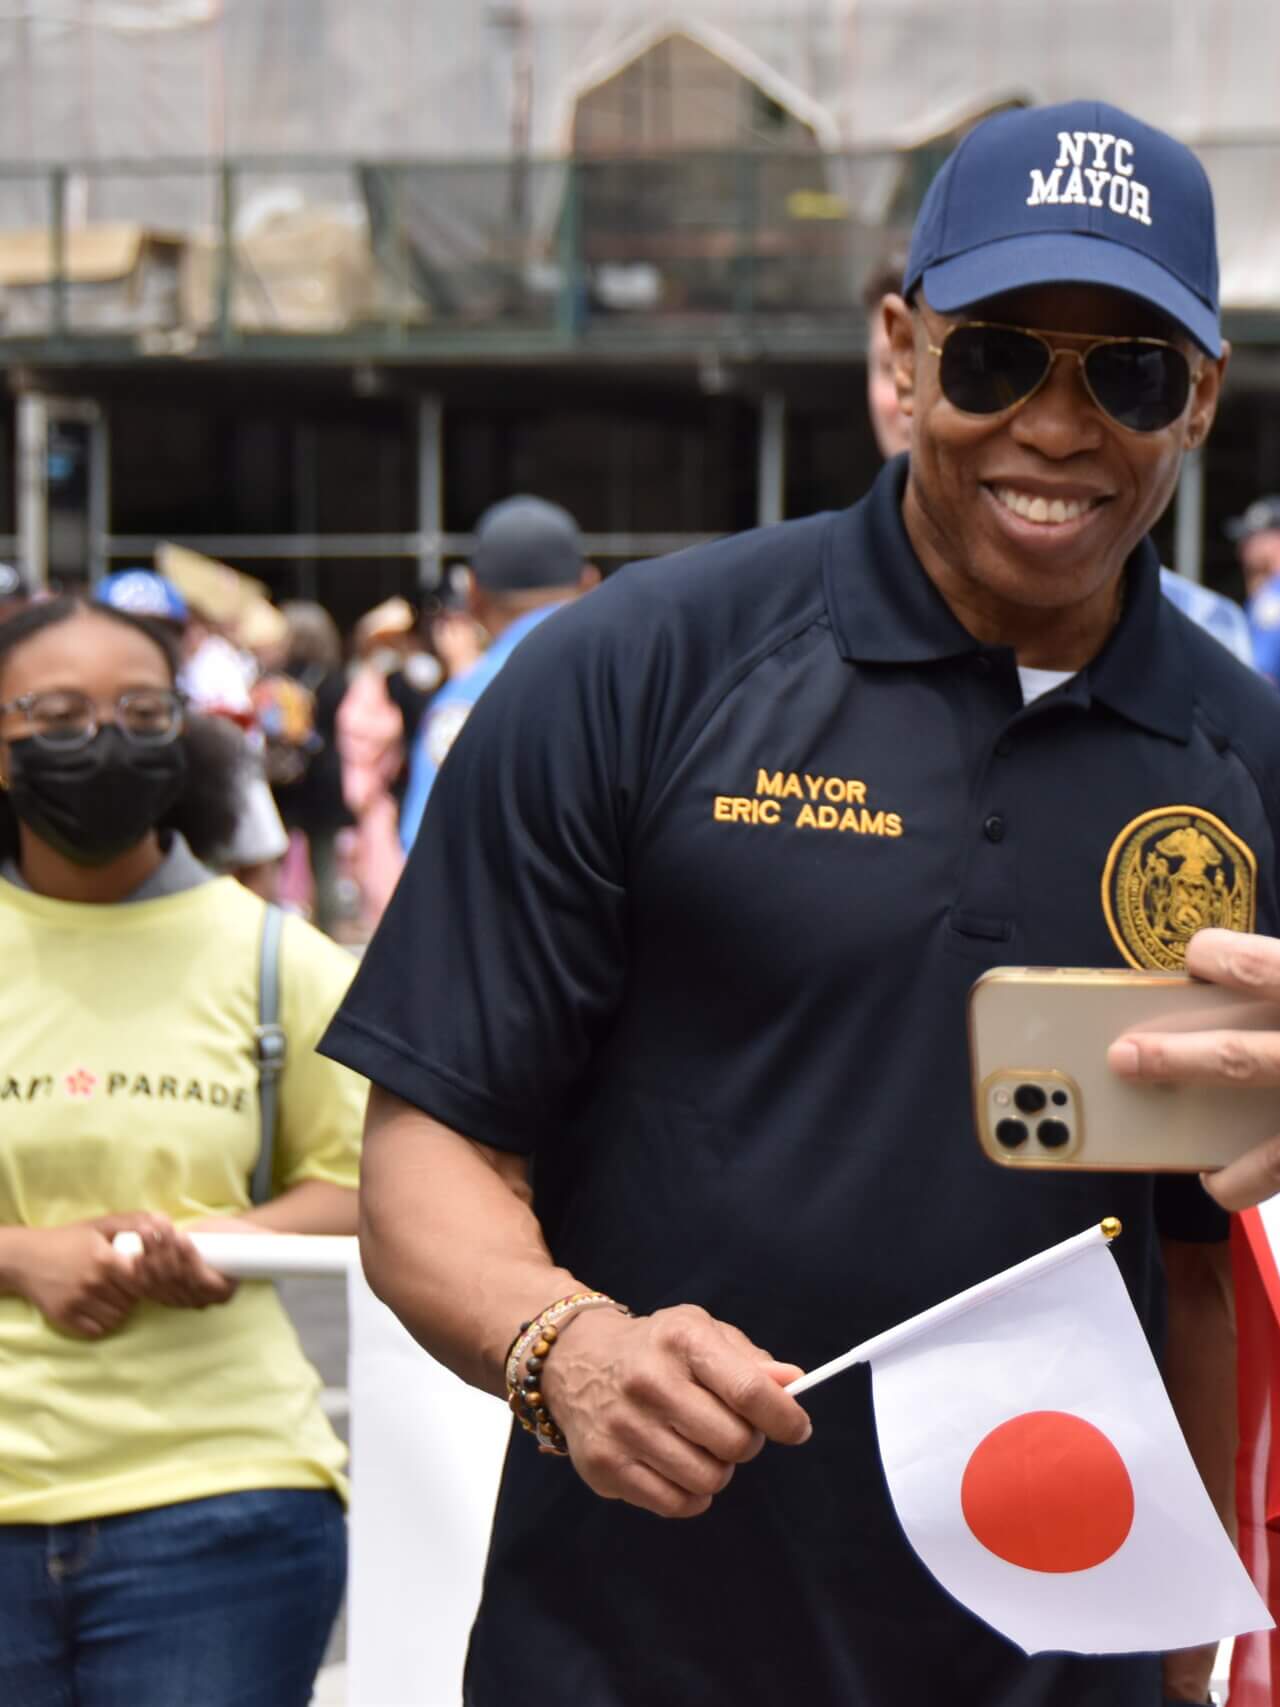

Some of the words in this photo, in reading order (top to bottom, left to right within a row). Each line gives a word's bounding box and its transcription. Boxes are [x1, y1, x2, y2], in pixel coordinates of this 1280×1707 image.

[1055, 131, 1134, 177] NYC
[1026, 167, 1152, 226] MAYOR
[756, 768, 867, 804] MAYOR
[714, 796, 781, 825] ERIC
[795, 804, 903, 838] ADAMS
[106, 1070, 248, 1112] PARADE
